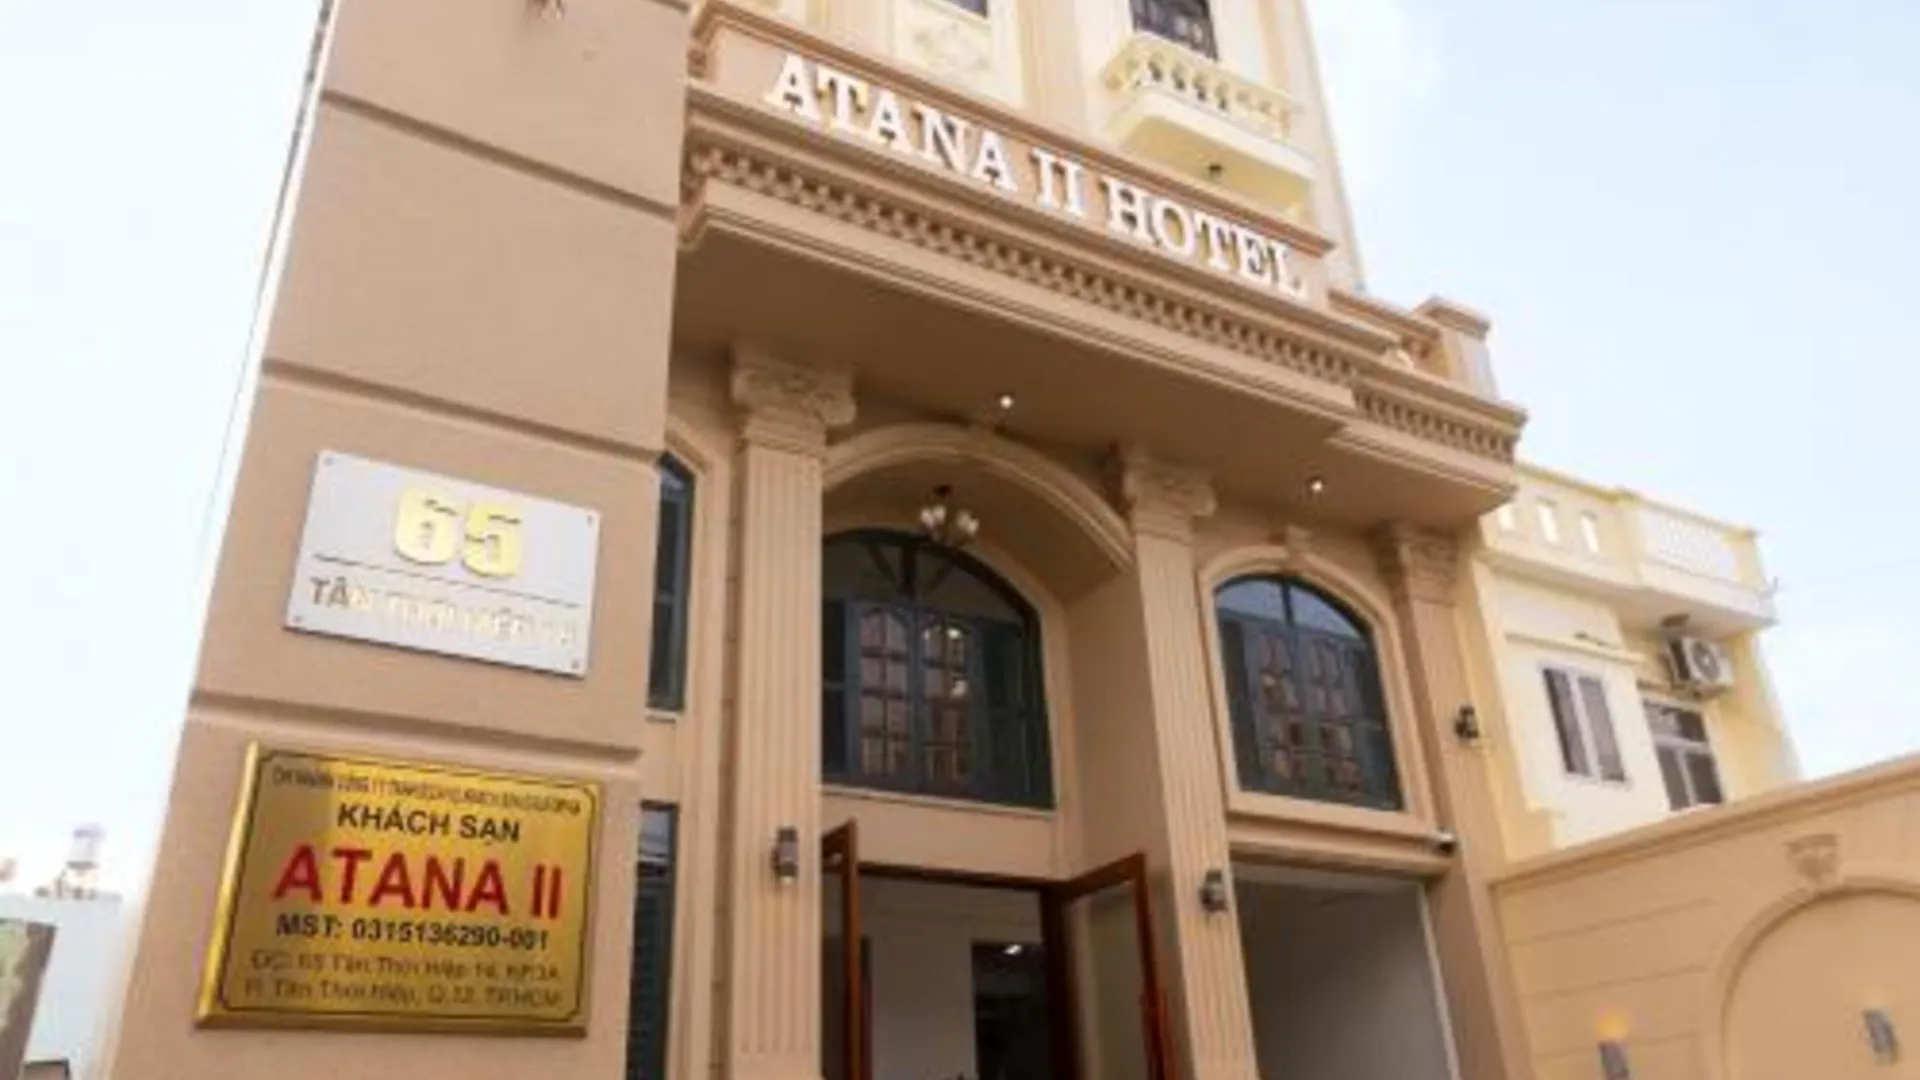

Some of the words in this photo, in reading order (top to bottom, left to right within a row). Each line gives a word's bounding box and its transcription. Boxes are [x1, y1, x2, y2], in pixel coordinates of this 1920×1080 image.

[764, 53, 1018, 193] ATANA
[1031, 147, 1084, 217] II
[1099, 174, 1308, 300] HOTEL
[394, 487, 523, 578] 65
[337, 800, 449, 836] KHÁCH
[459, 814, 520, 845] SẠN
[273, 843, 510, 916] ATANA
[531, 863, 563, 920] II
[276, 913, 342, 940] MST:
